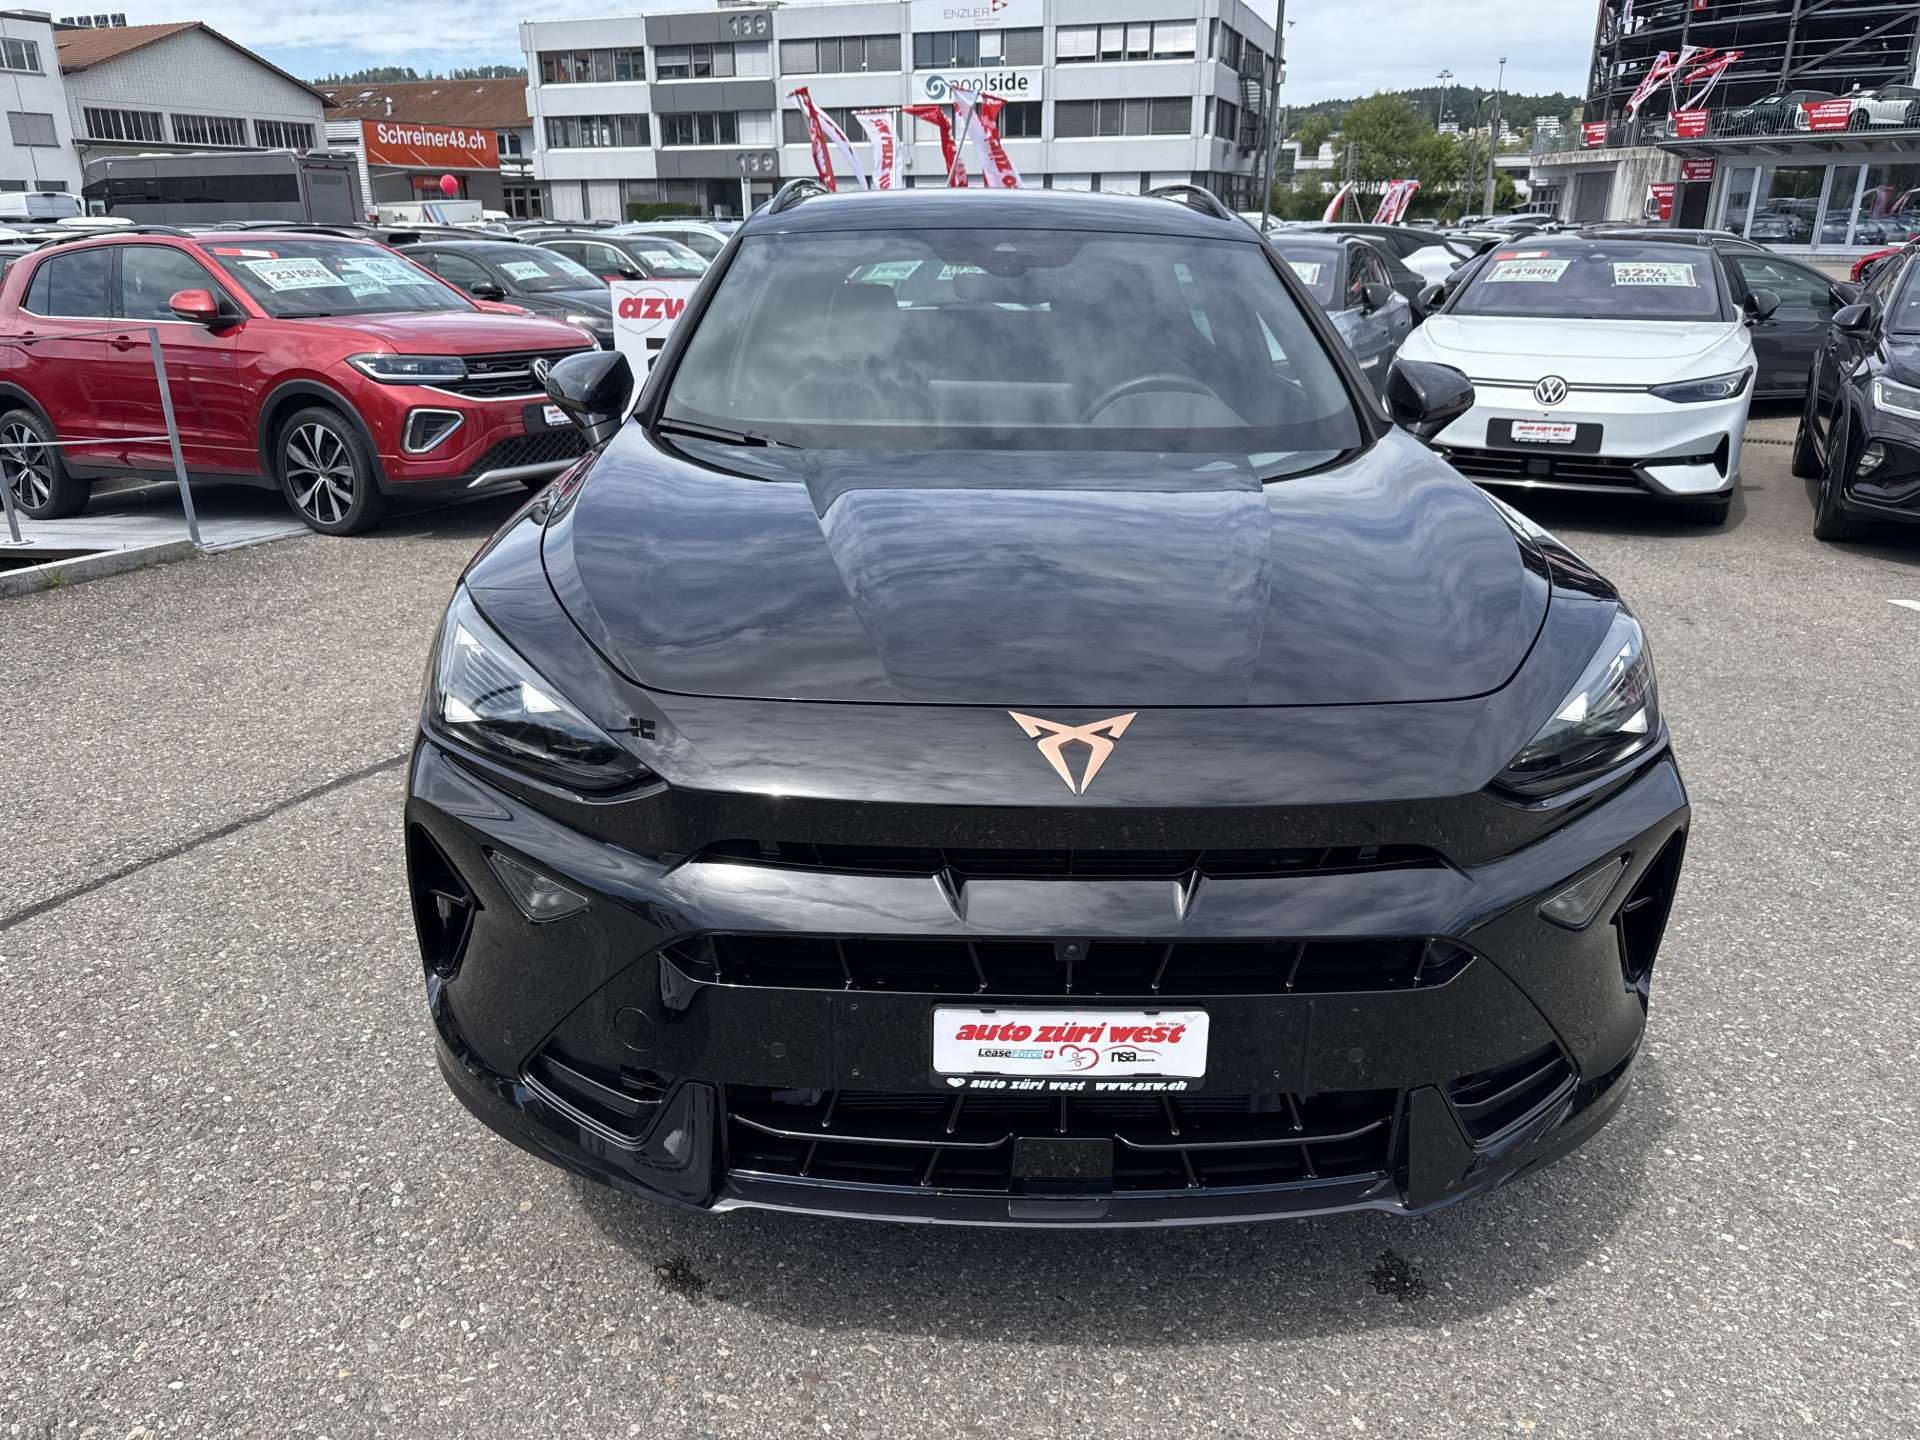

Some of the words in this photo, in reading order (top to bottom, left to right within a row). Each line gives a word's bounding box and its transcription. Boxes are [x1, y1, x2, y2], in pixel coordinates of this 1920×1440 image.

[943, 8, 990, 19] ENZLER
[730, 15, 766, 35] 139
[949, 72, 1029, 100] poolside
[377, 123, 487, 150] Schreiner48.ch
[737, 152, 773, 171] 139
[1616, 268, 1668, 277] 32%
[955, 1021, 1033, 1042] auto
[1032, 1022, 1107, 1043] züri
[1109, 1023, 1187, 1044] west
[1111, 1051, 1137, 1063] nsa
[969, 1079, 1006, 1089] auto
[1009, 1078, 1046, 1090] züri
[1049, 1080, 1086, 1091] west
[1095, 1080, 1188, 1092] www.azw.ch
